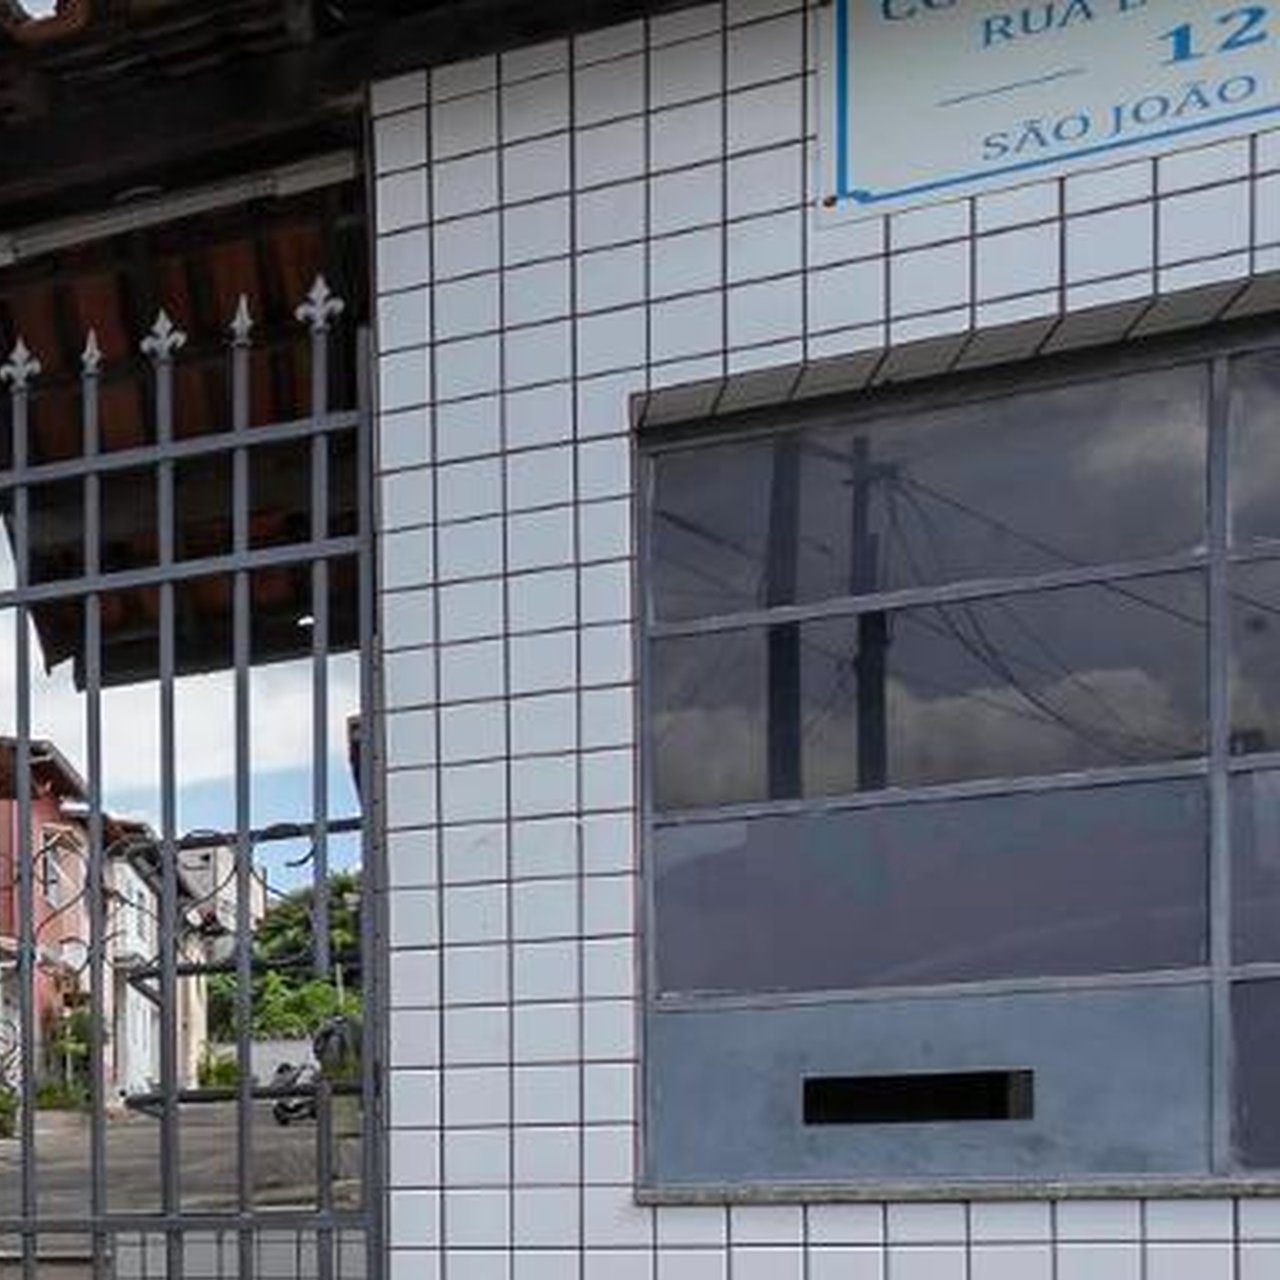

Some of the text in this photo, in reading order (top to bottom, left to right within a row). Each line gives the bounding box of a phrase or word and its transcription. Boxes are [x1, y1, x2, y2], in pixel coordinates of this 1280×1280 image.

[982, 0, 1093, 48] RUA
[982, 75, 1258, 160] SÃO JOÃO
